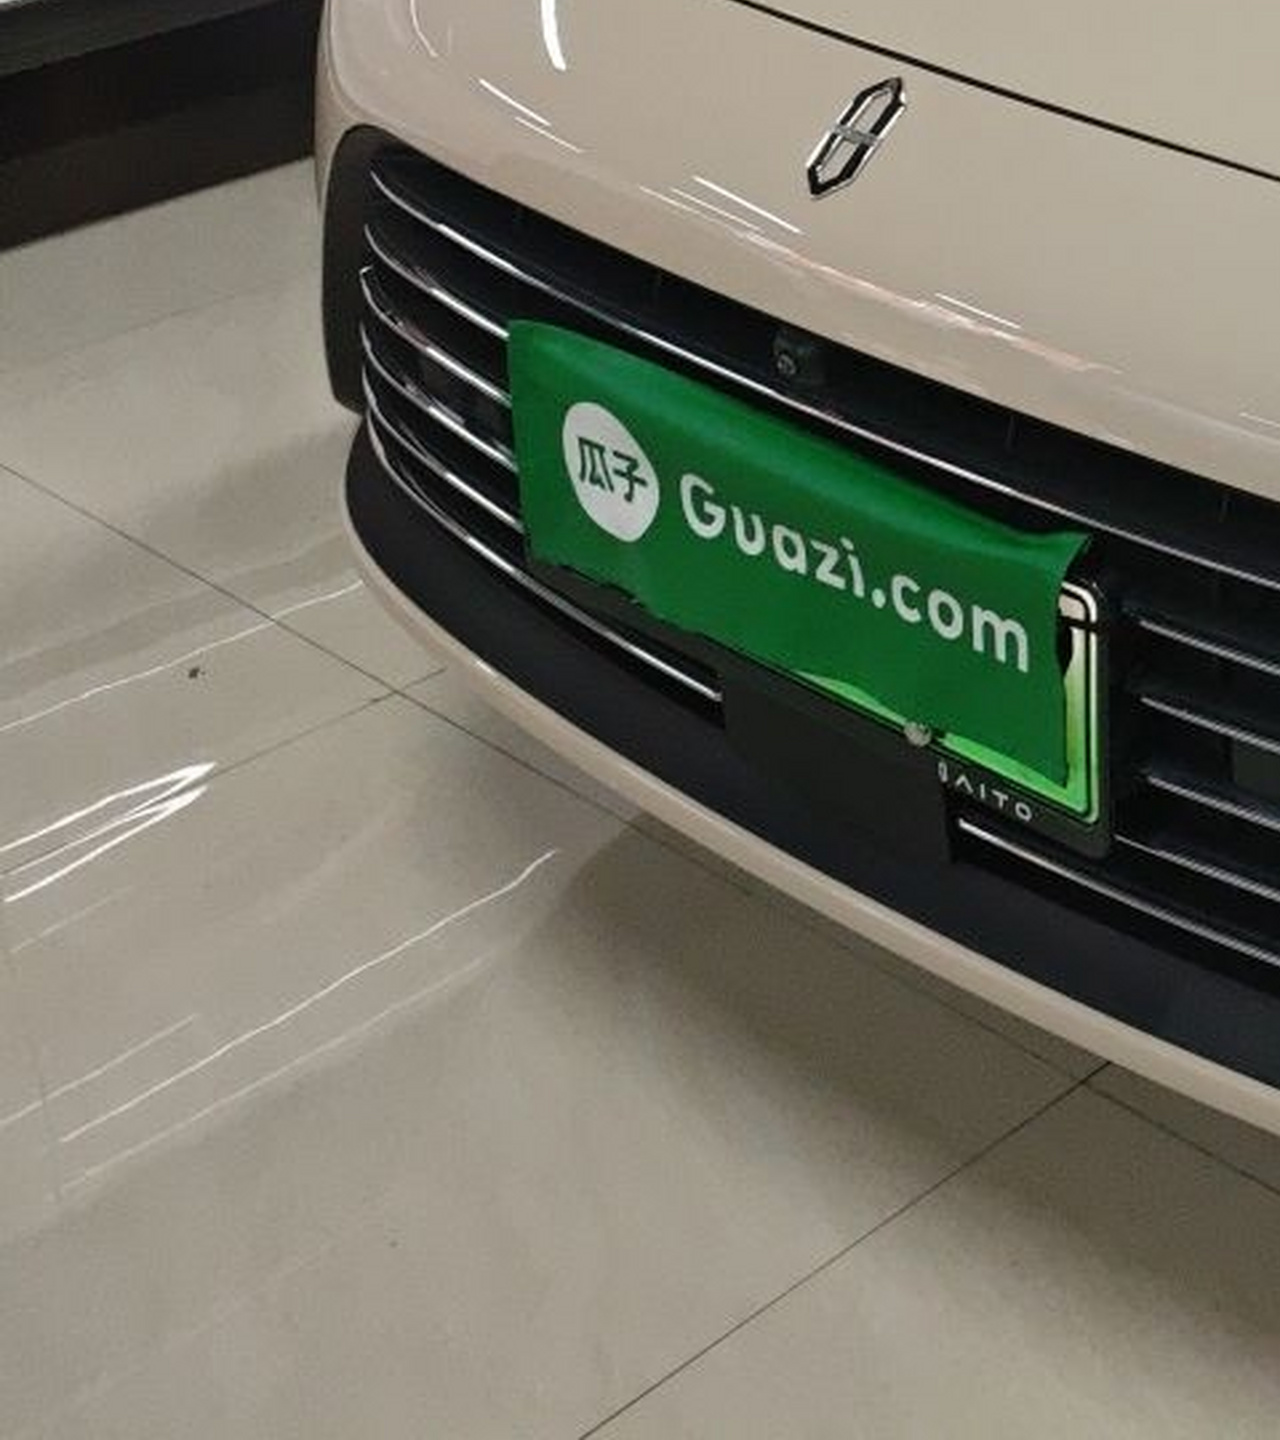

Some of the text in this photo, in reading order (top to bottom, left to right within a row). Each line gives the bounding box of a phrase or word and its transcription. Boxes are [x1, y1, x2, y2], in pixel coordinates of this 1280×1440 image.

[577, 436, 648, 503] 瓜子
[680, 473, 1029, 673] Guazi.com
[955, 774, 1033, 823] AITO
